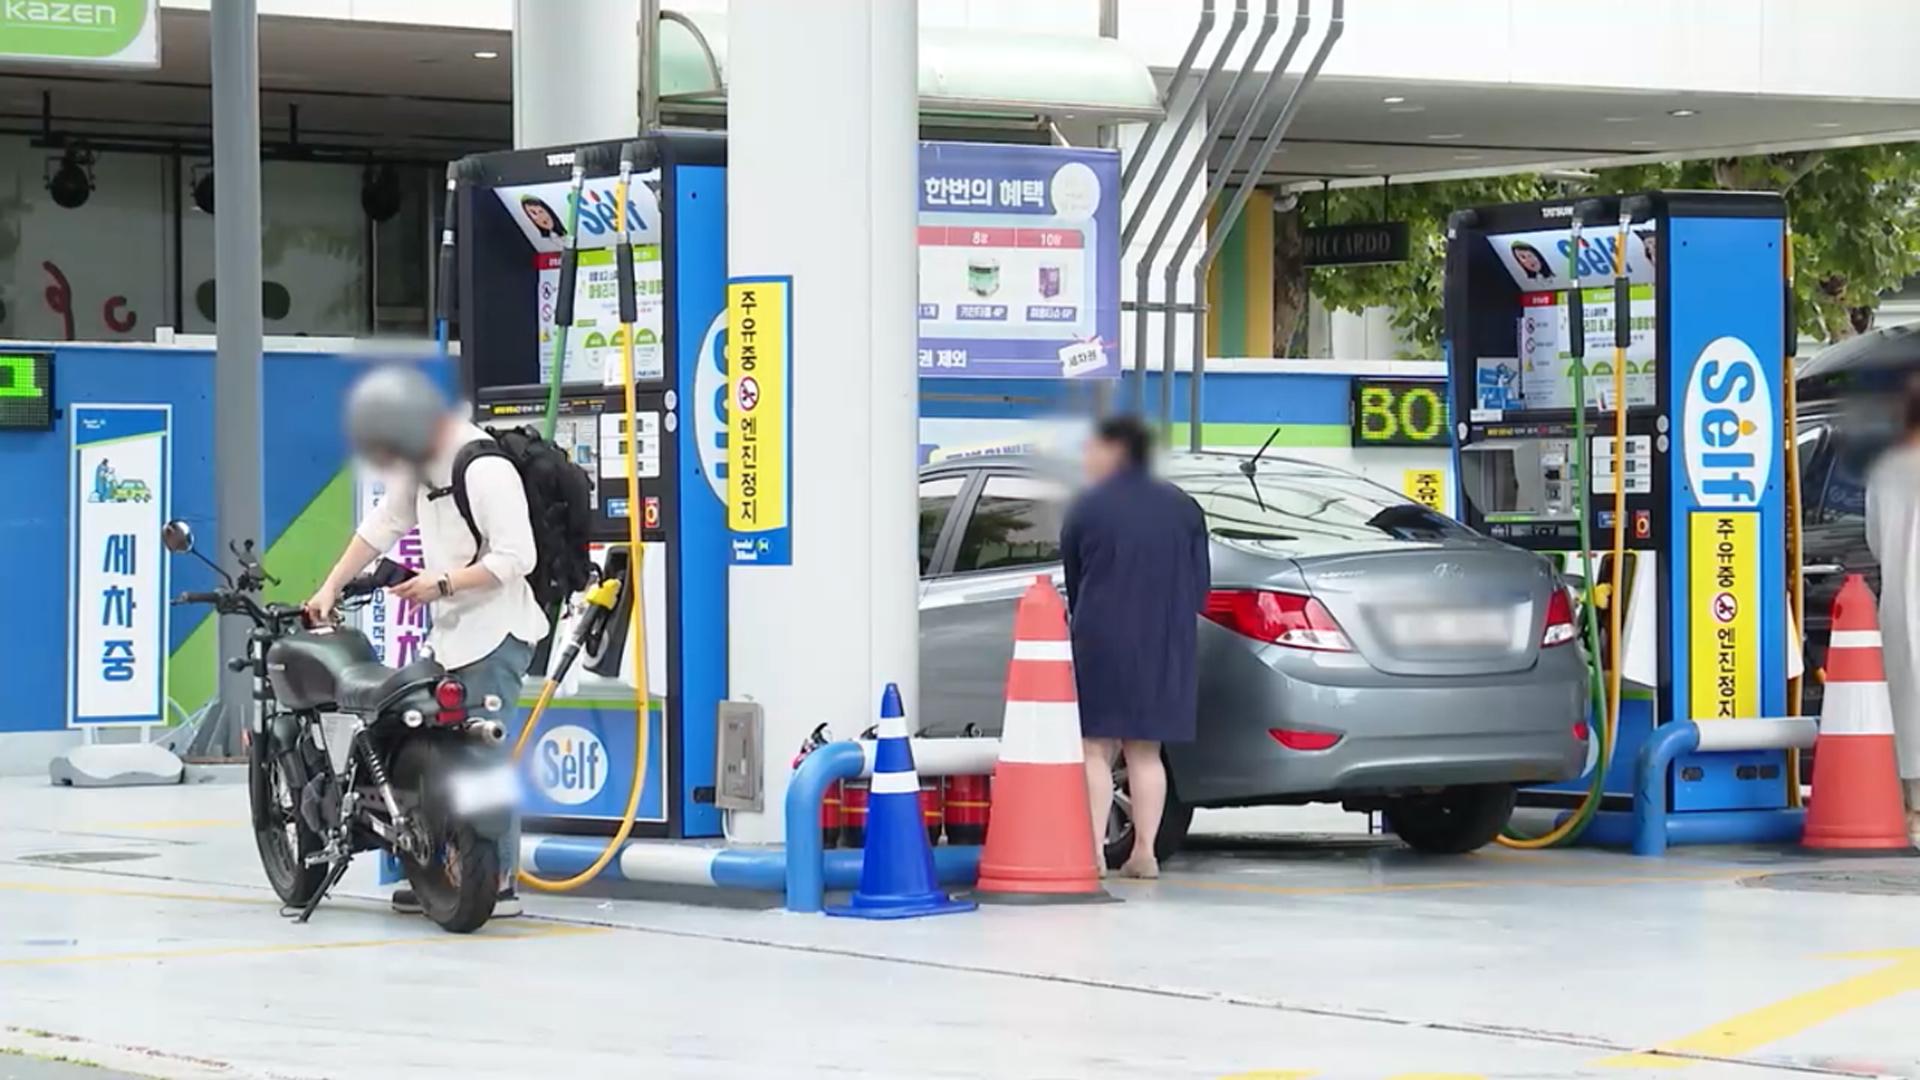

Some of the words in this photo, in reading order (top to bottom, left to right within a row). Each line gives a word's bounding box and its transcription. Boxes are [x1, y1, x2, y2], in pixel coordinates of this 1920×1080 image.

[925, 176, 993, 206] 한번의
[999, 179, 1045, 208] 혜택
[740, 290, 758, 371] 주유중
[936, 349, 967, 368] 제외
[740, 416, 758, 525] 엔진정지
[1701, 360, 1756, 504] Self
[1715, 518, 1736, 588] 주유중
[101, 532, 137, 682] 세차중
[1715, 628, 1737, 720] 엔진정지
[541, 737, 600, 790] Self
